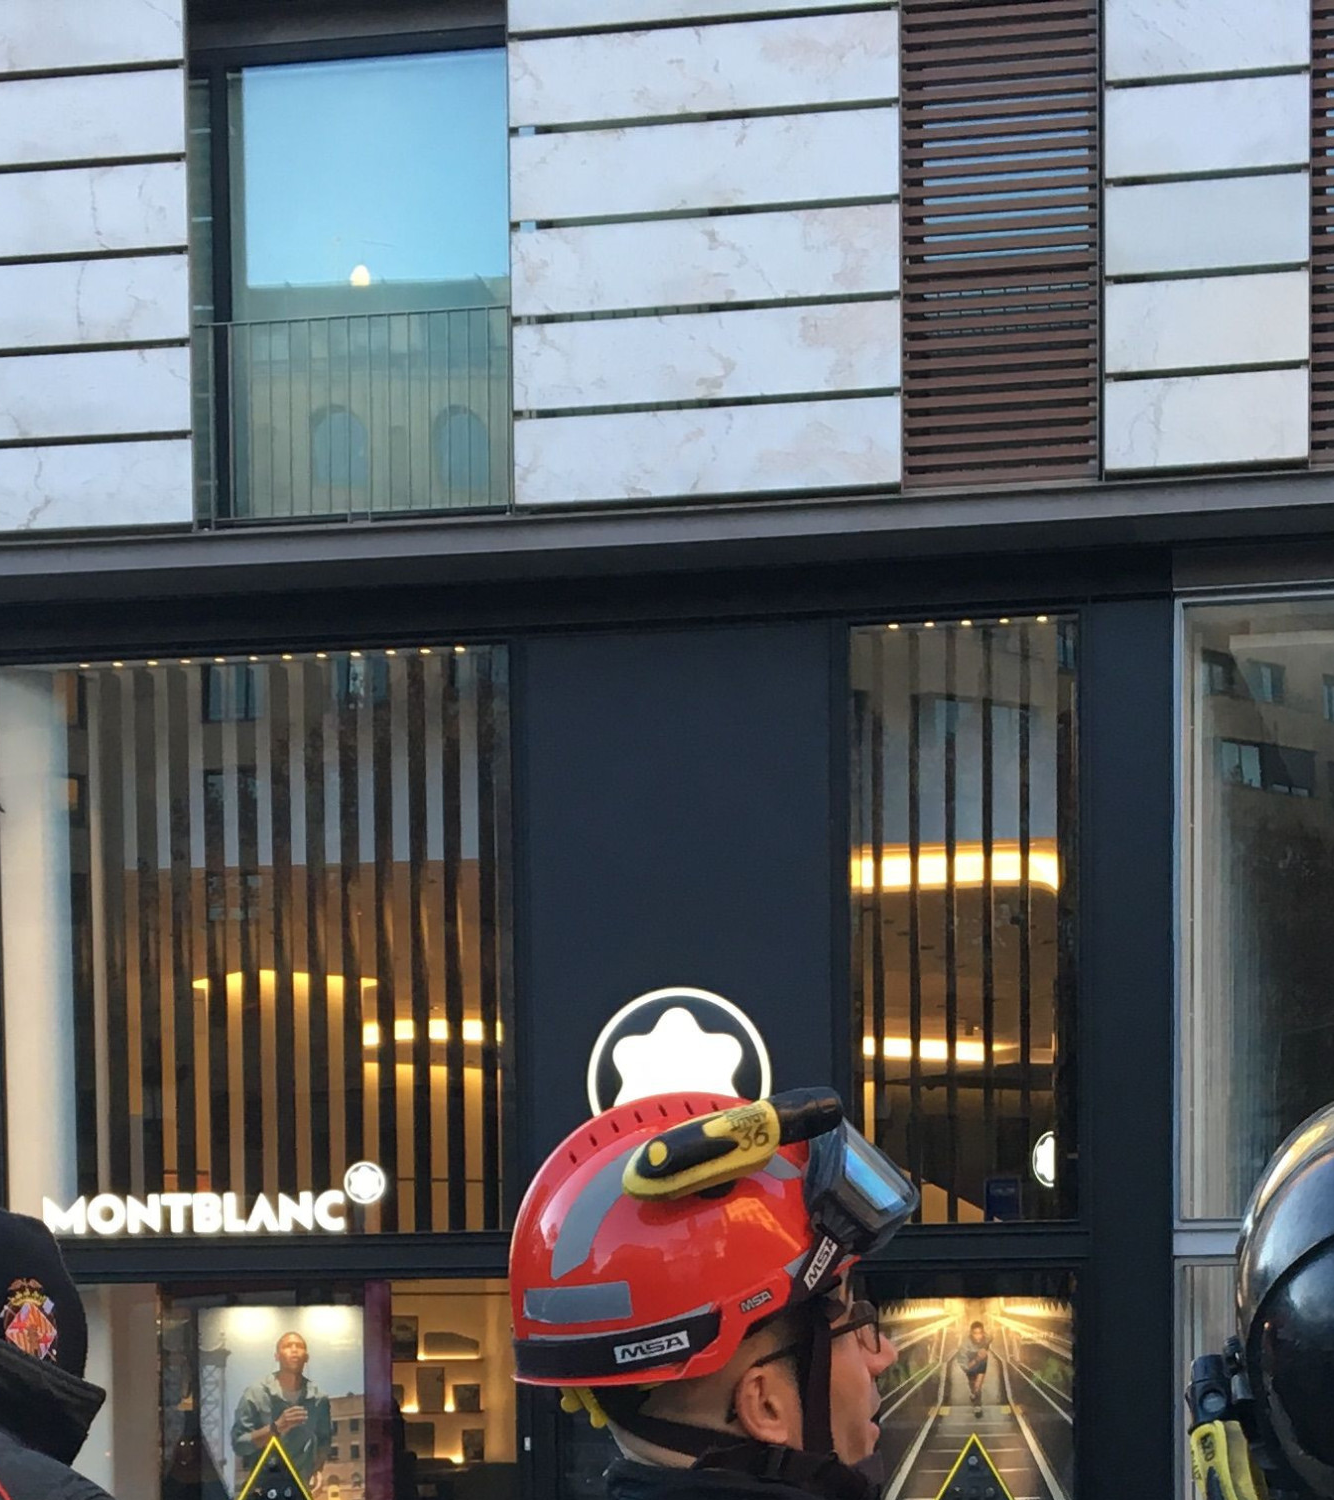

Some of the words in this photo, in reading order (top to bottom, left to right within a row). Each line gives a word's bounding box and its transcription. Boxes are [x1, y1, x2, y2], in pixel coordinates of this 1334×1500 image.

[42, 1190, 346, 1235] MONTBLANC
[741, 1290, 772, 1313] MSA
[621, 1332, 685, 1359] MSA
